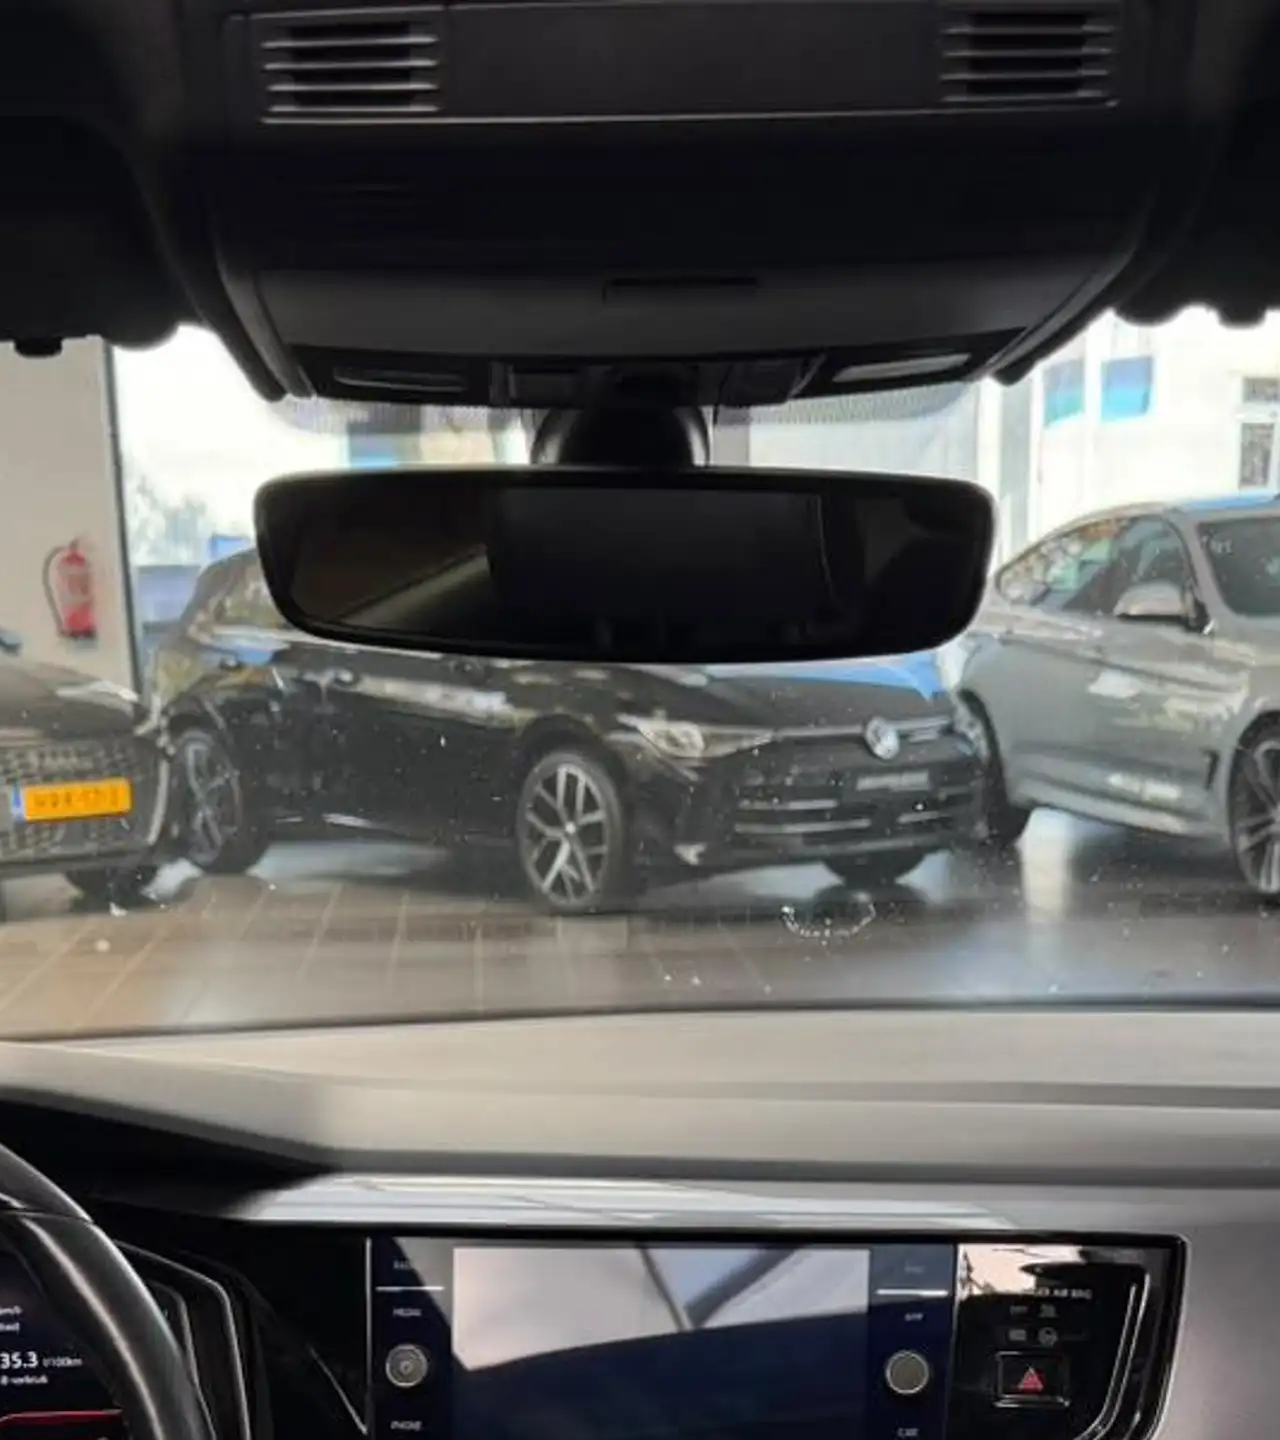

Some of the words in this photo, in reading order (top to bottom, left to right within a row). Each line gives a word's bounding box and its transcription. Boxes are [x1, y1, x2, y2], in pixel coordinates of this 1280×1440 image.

[392, 1307, 422, 1318] MEDIA
[0, 1351, 39, 1369] 35.3
[391, 1420, 423, 1431] PHONE
